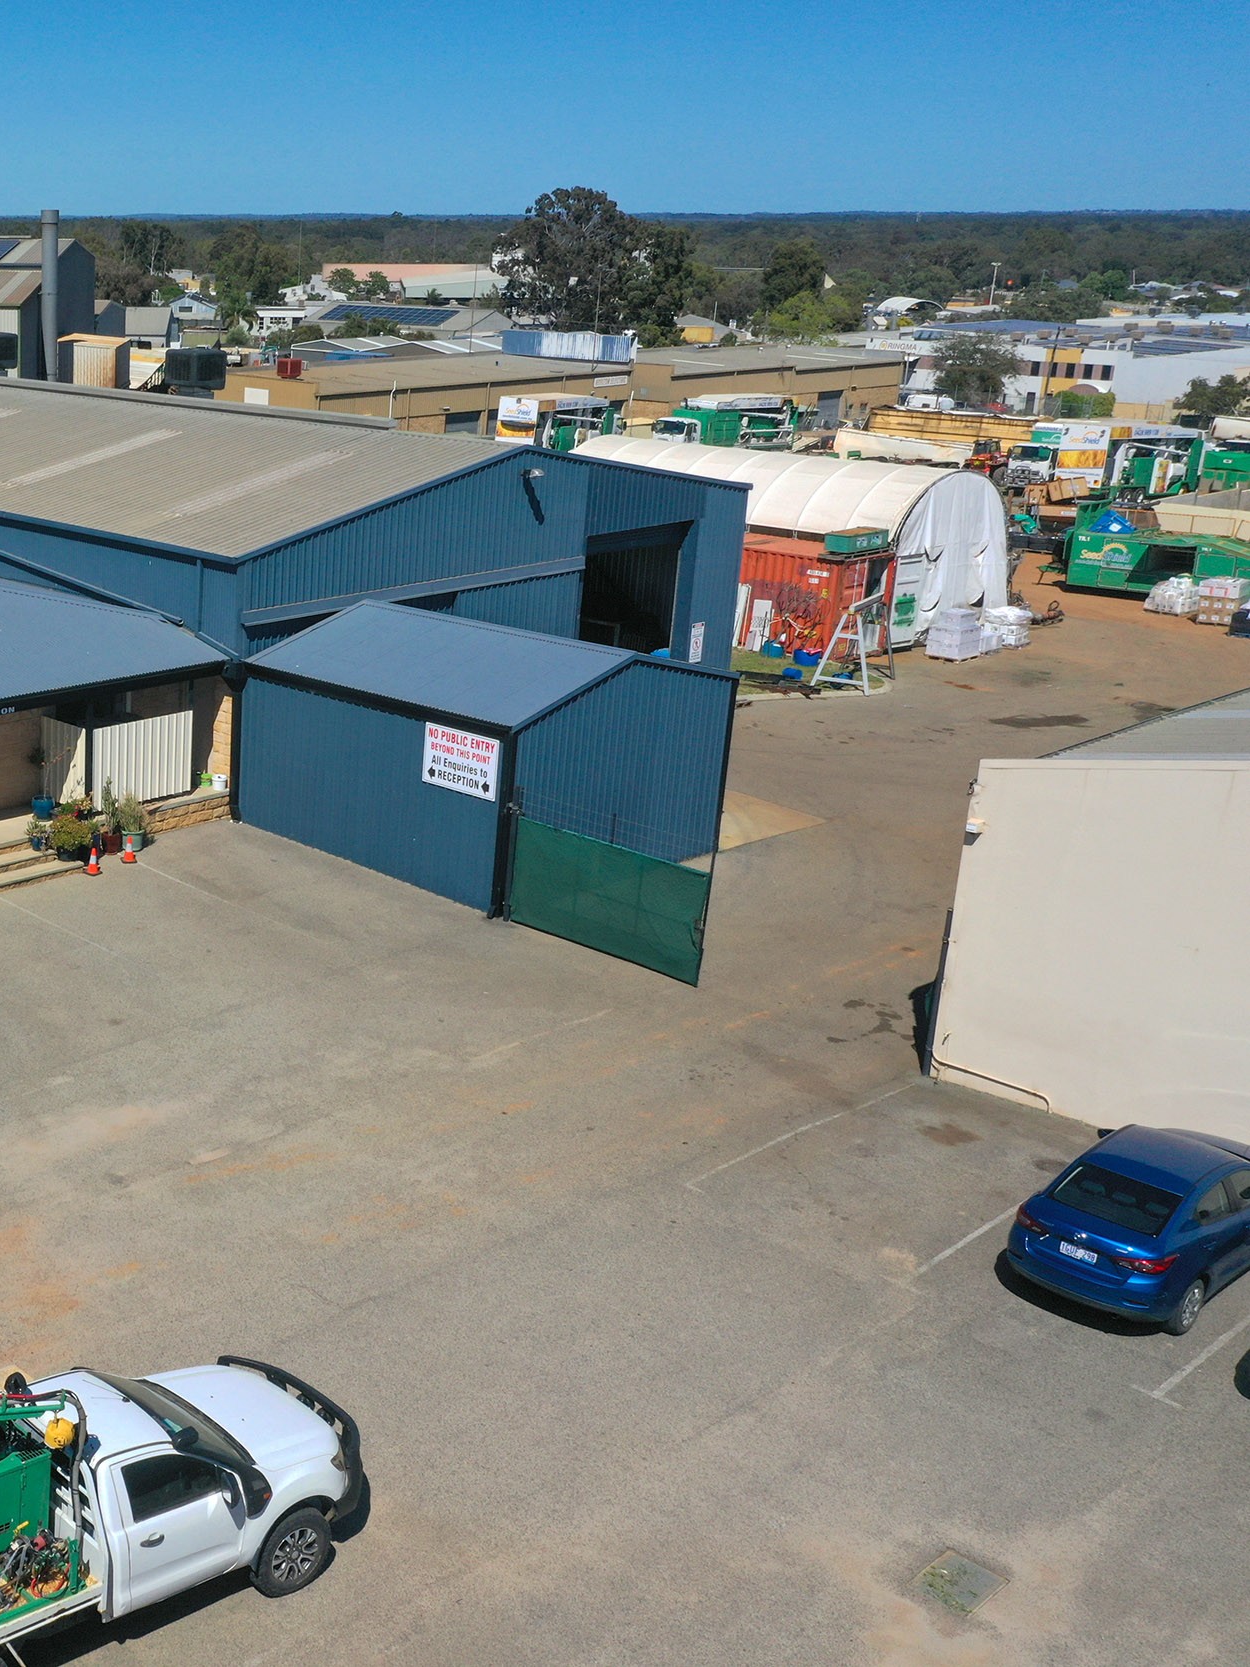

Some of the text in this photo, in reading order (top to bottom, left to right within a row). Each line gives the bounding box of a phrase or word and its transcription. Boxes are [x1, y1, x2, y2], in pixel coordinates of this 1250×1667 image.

[428, 727, 496, 754] NO PUBLIC ENTRY
[430, 741, 491, 765] BEYOND THIS POINT
[431, 755, 488, 779] All Enquiries to
[437, 769, 480, 790] RECEPTION
